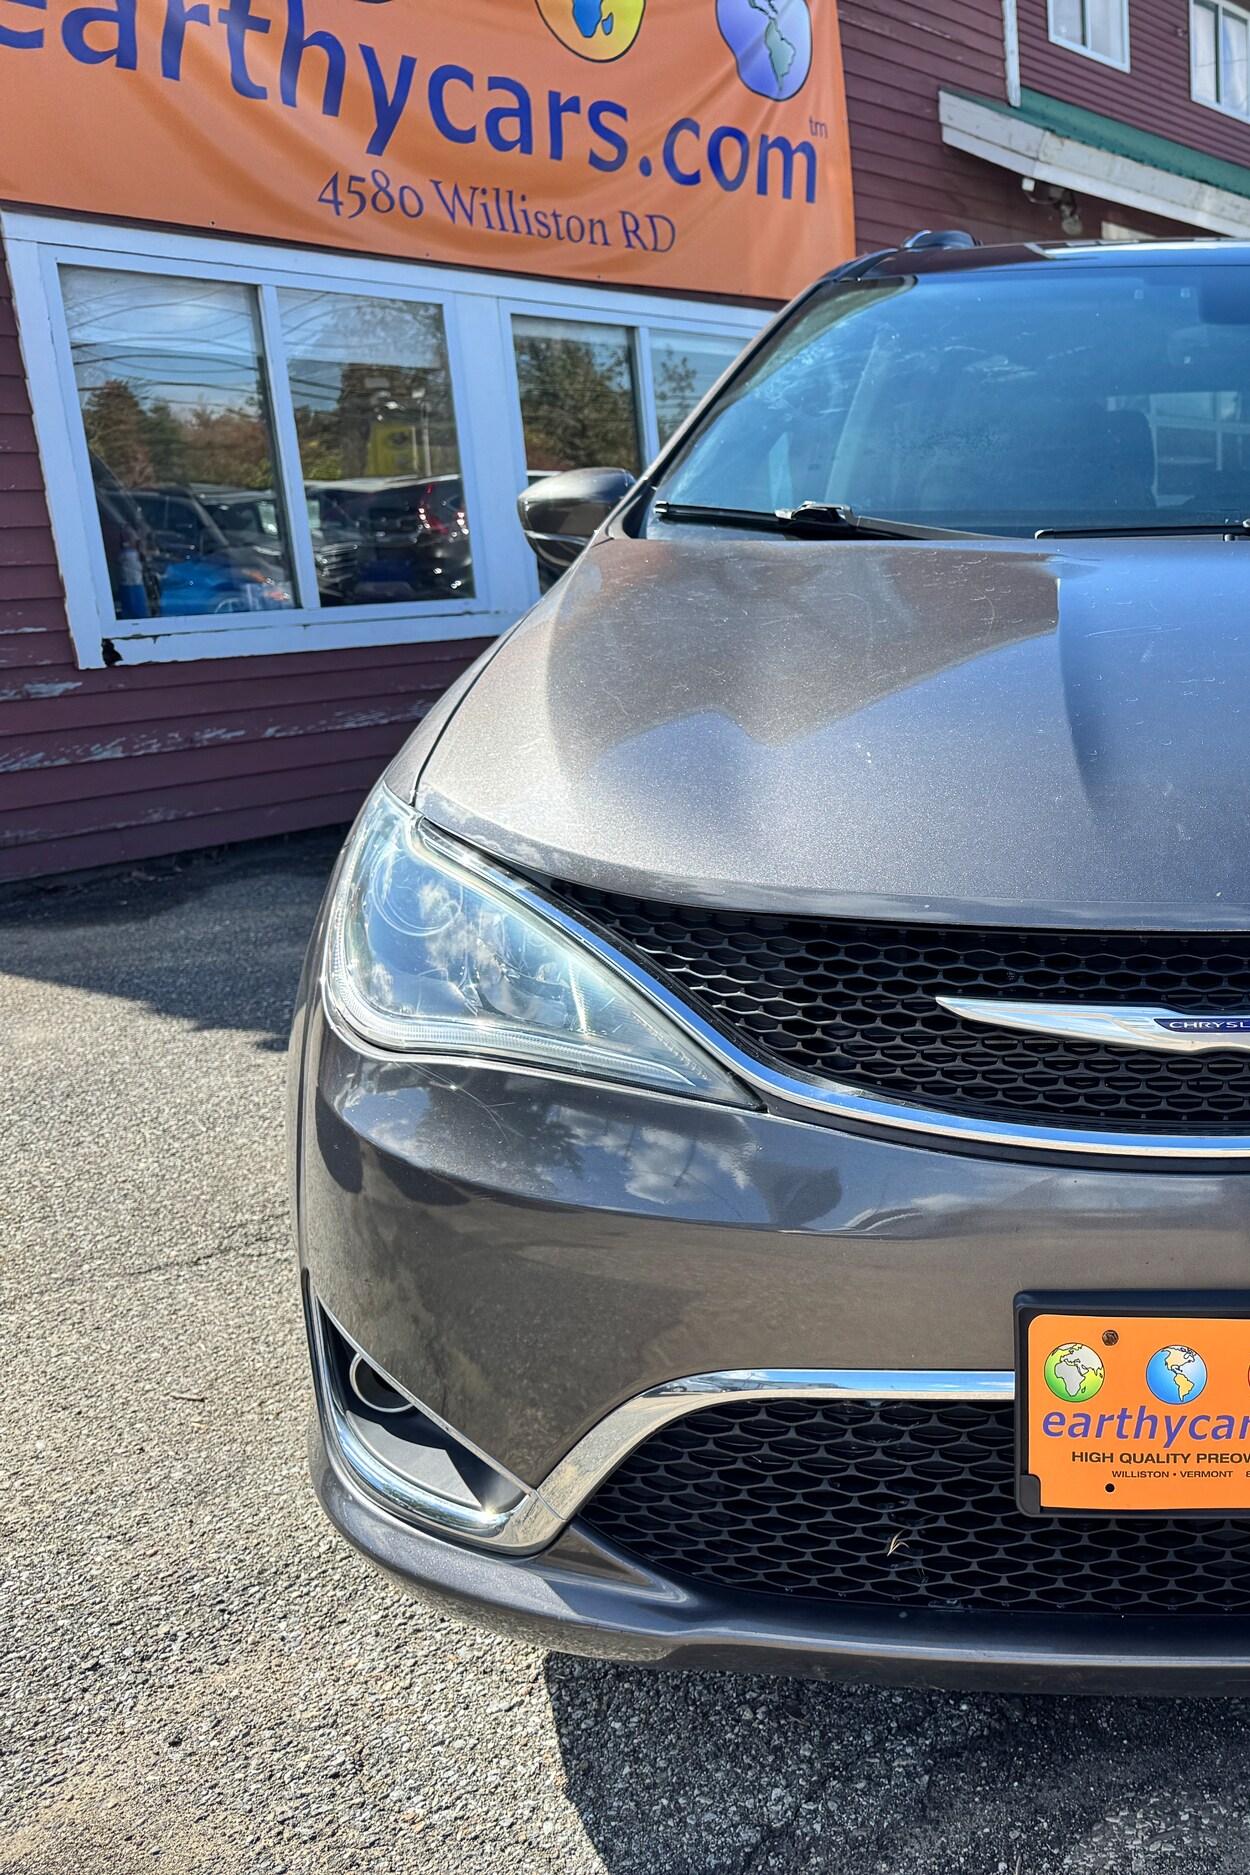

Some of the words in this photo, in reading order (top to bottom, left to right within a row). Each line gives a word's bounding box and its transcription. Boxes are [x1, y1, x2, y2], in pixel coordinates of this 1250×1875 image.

[317, 169, 424, 219] 4580
[429, 179, 611, 247] Williston
[620, 210, 676, 253] RD
[1072, 1451, 1114, 1463] HIGH
[1119, 1452, 1191, 1464] QUALITY
[1112, 1470, 1170, 1478] WILLISTON
[1179, 1470, 1234, 1478] VERMONT
